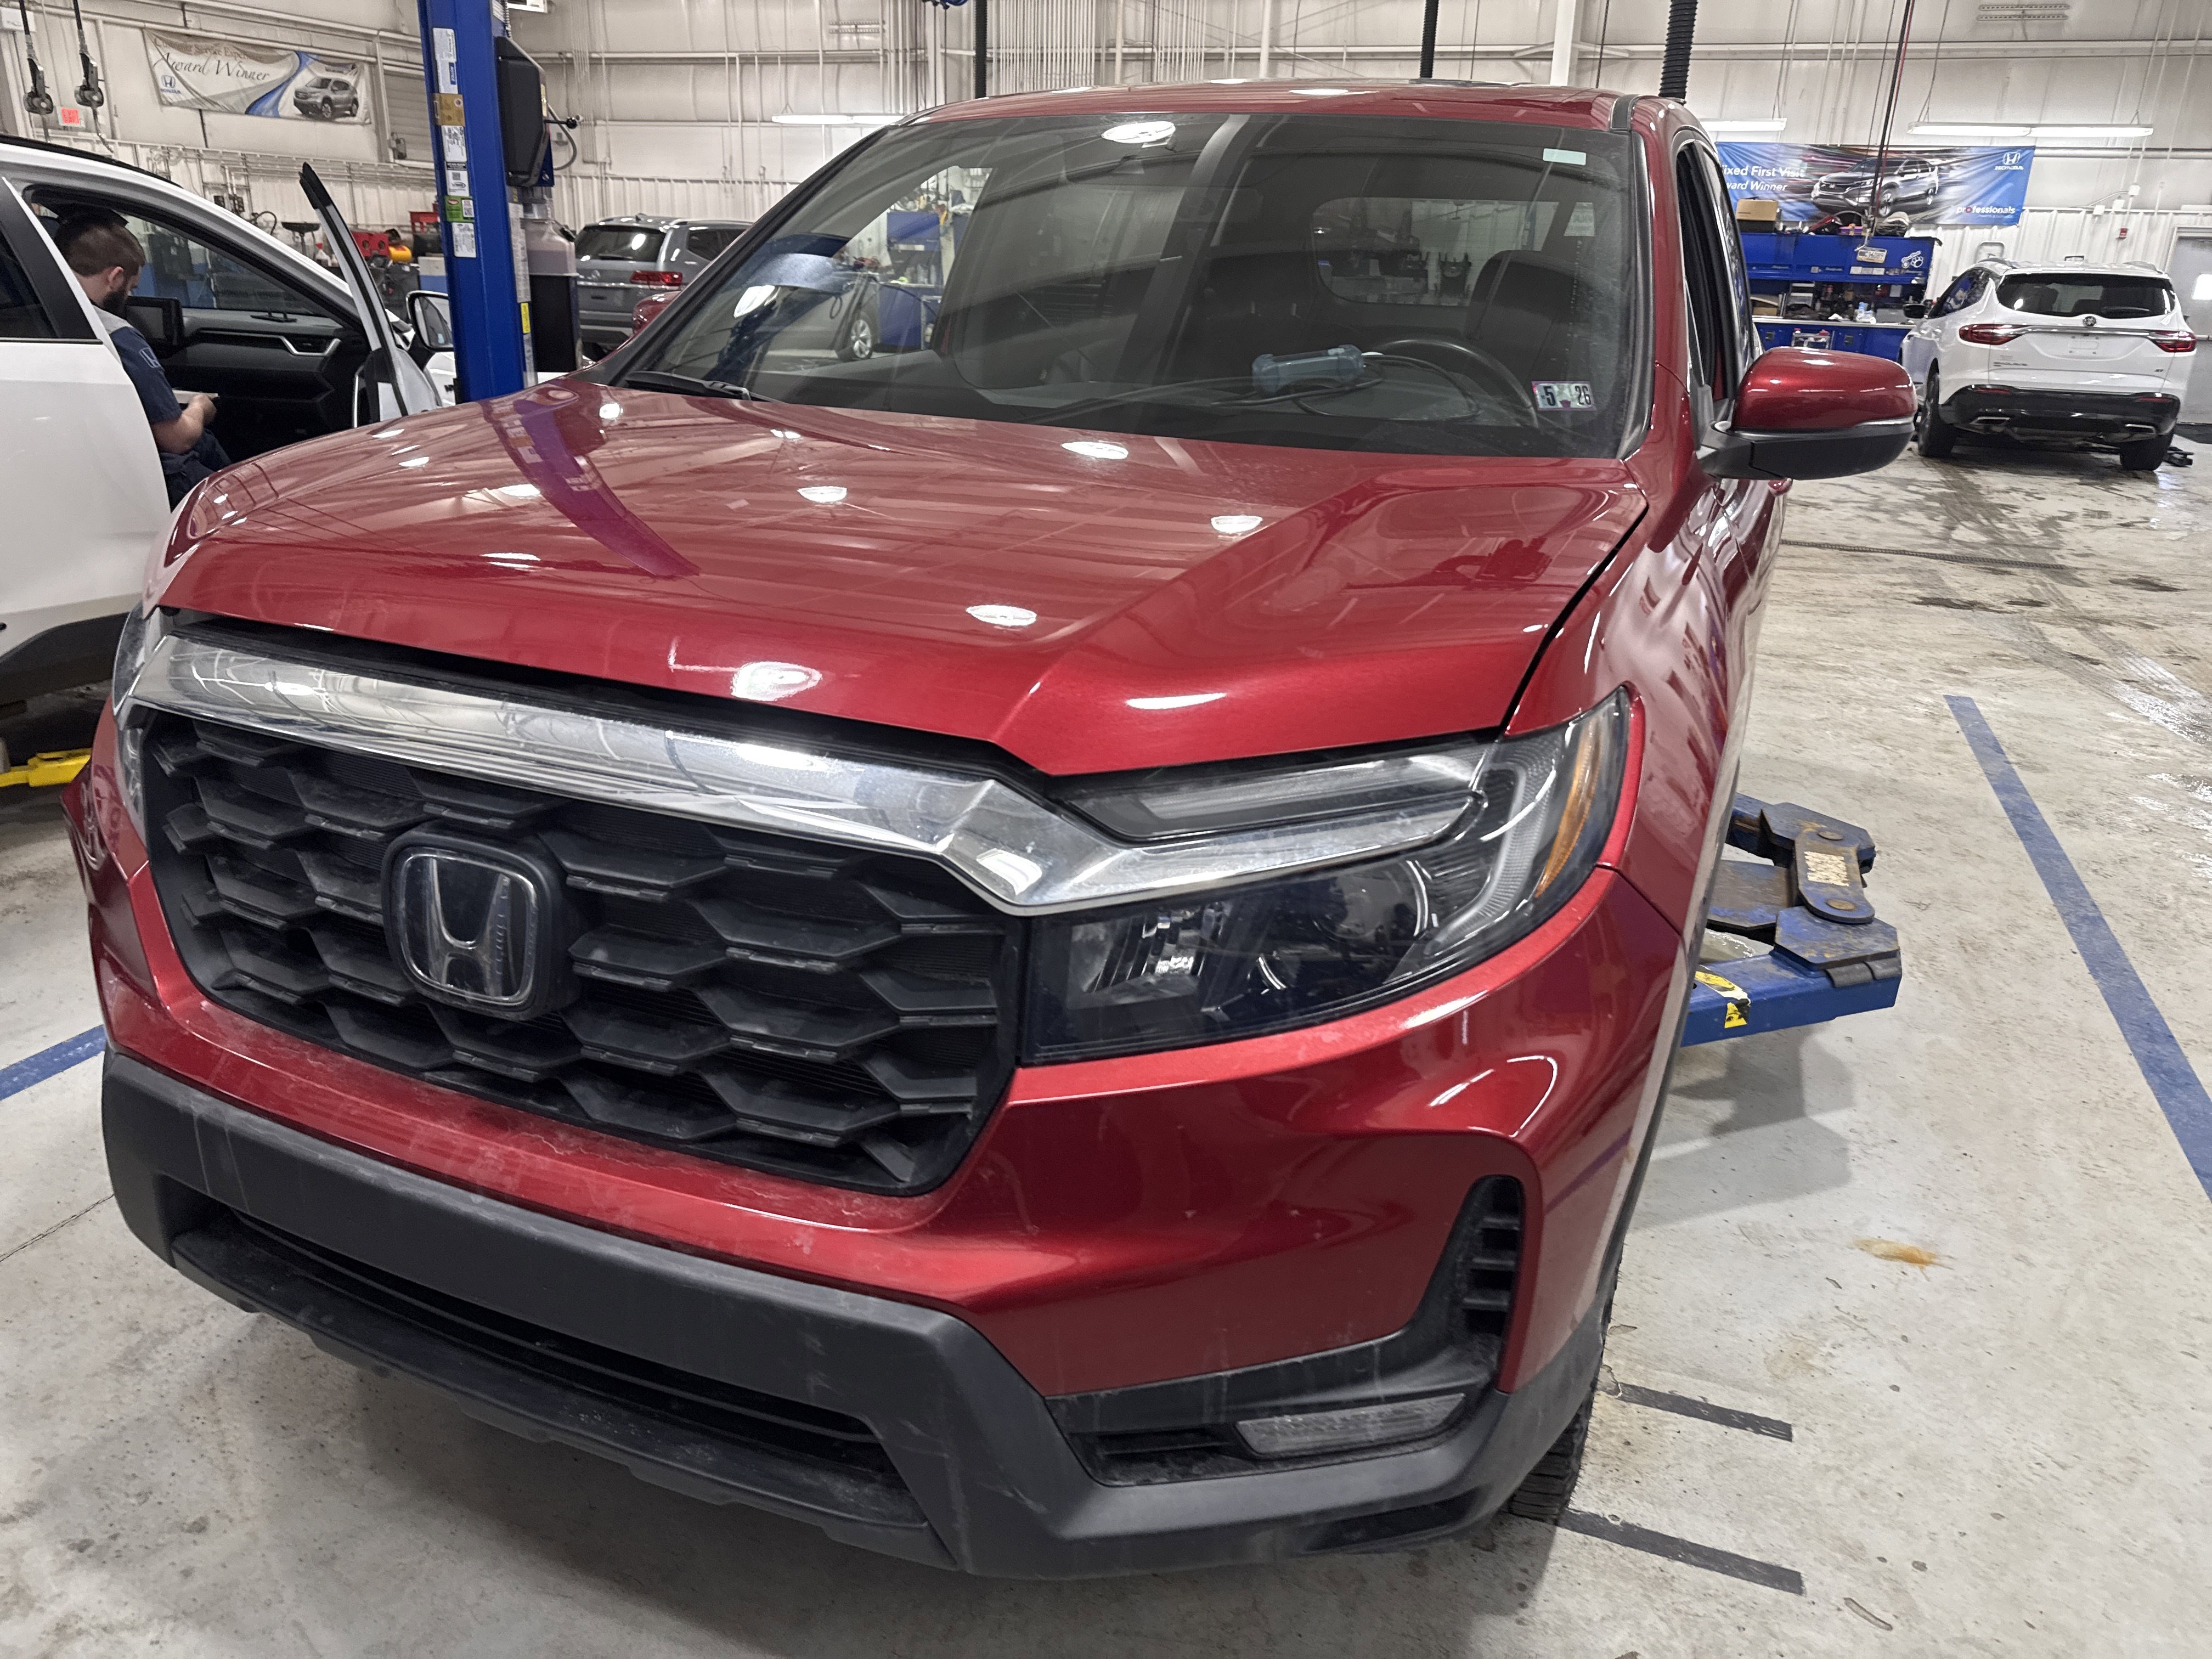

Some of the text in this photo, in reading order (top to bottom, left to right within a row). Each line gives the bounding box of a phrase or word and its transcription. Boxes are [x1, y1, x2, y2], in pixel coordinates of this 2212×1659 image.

[216, 60, 270, 81] Winner
[1722, 165, 1807, 177] ixed First Visit
[1751, 181, 1788, 191] Winner
[1956, 205, 2016, 214] professionals
[1543, 385, 1592, 406] 5 26
